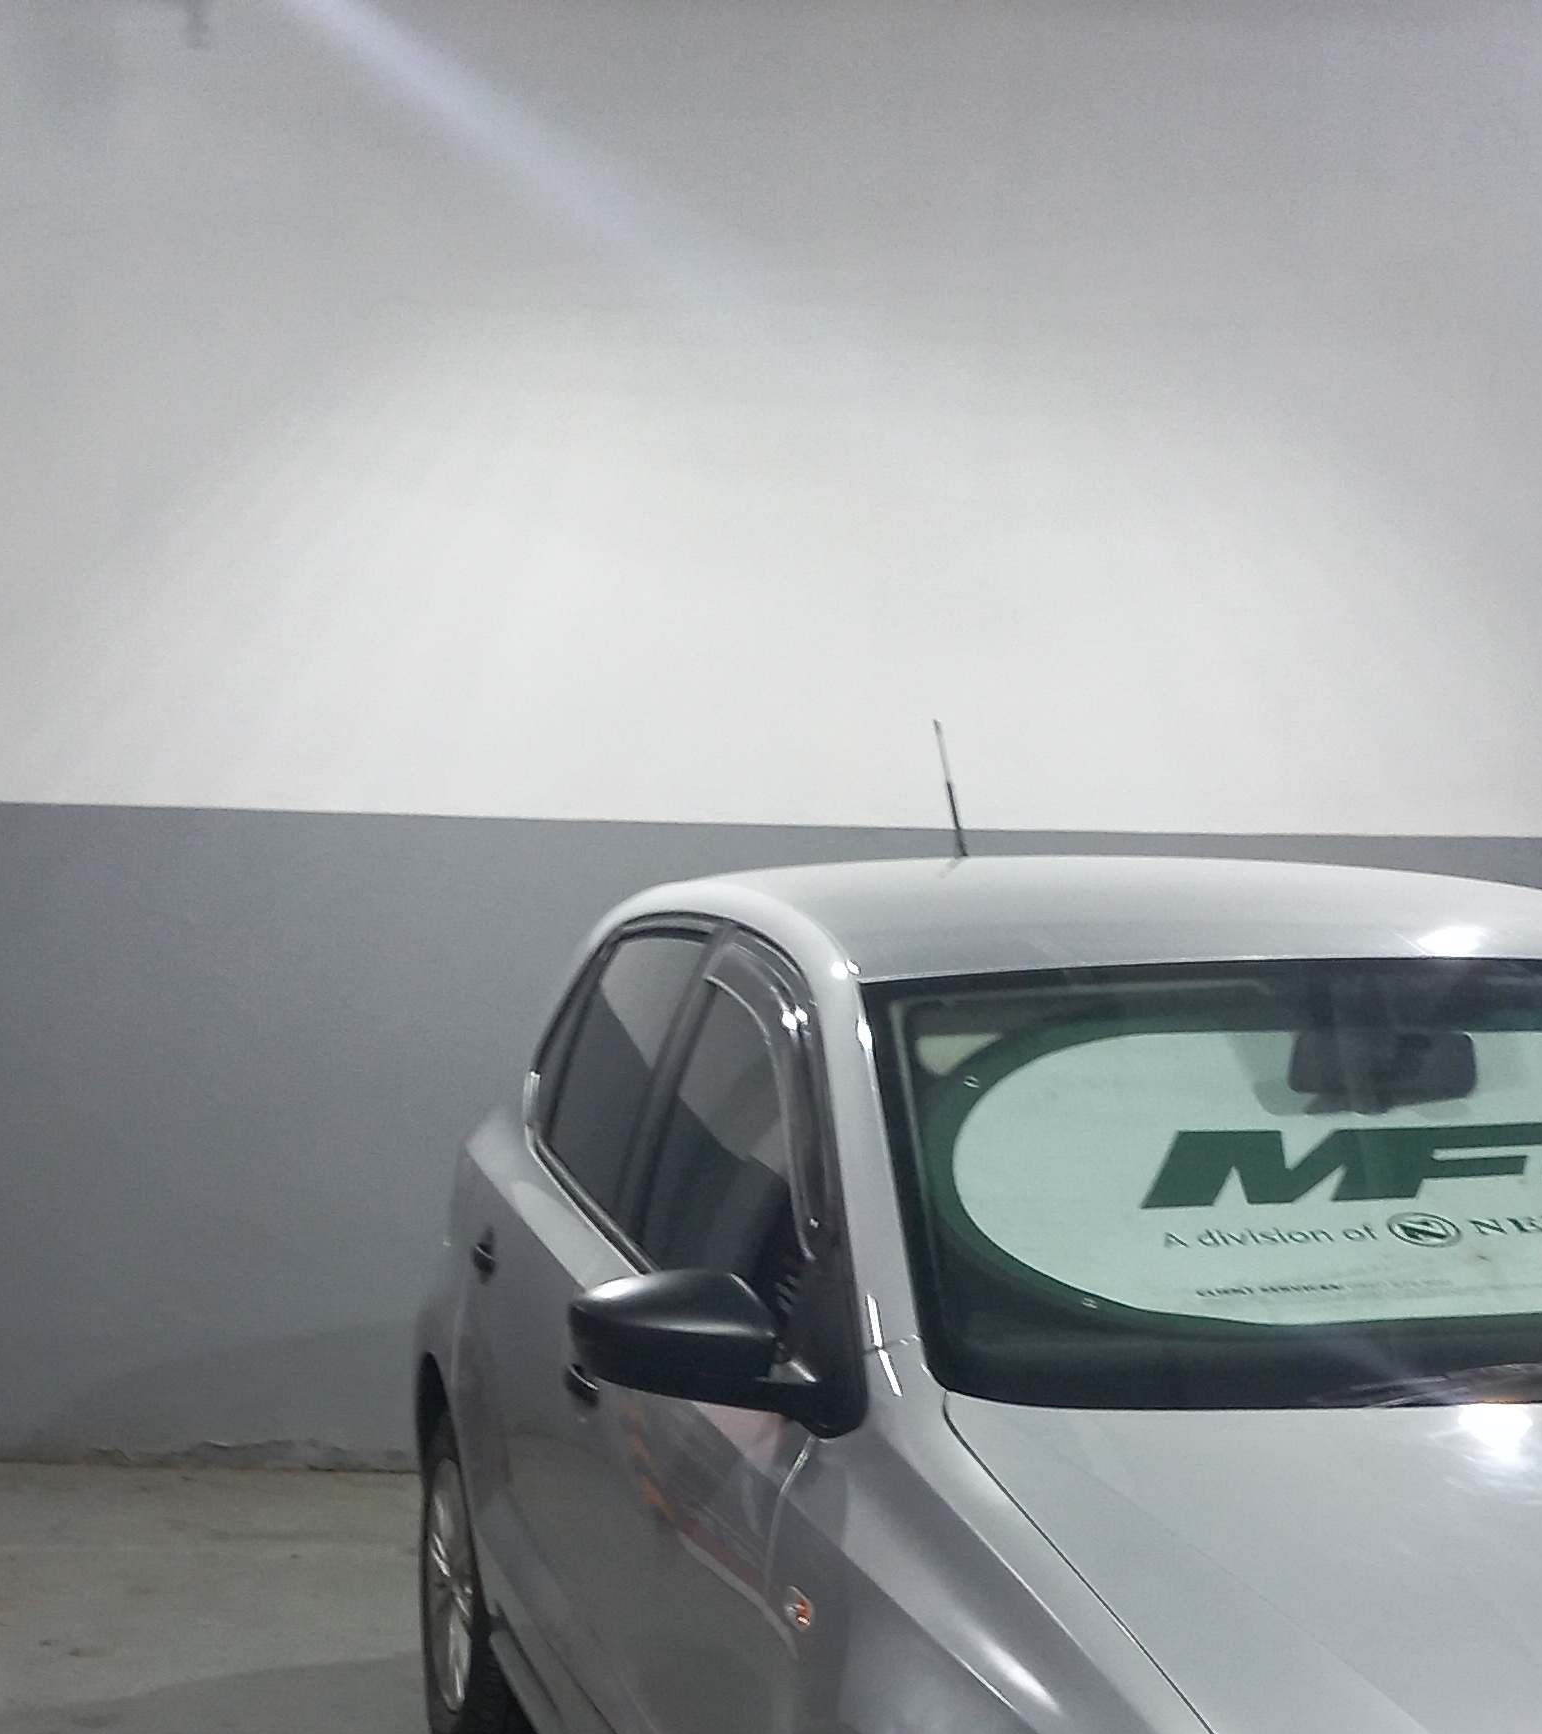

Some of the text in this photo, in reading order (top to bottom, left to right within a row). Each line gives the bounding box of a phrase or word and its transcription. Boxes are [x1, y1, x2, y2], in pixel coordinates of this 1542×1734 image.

[1163, 1231, 1189, 1249] A
[1197, 1226, 1334, 1247] division
[1344, 1221, 1379, 1243] of
